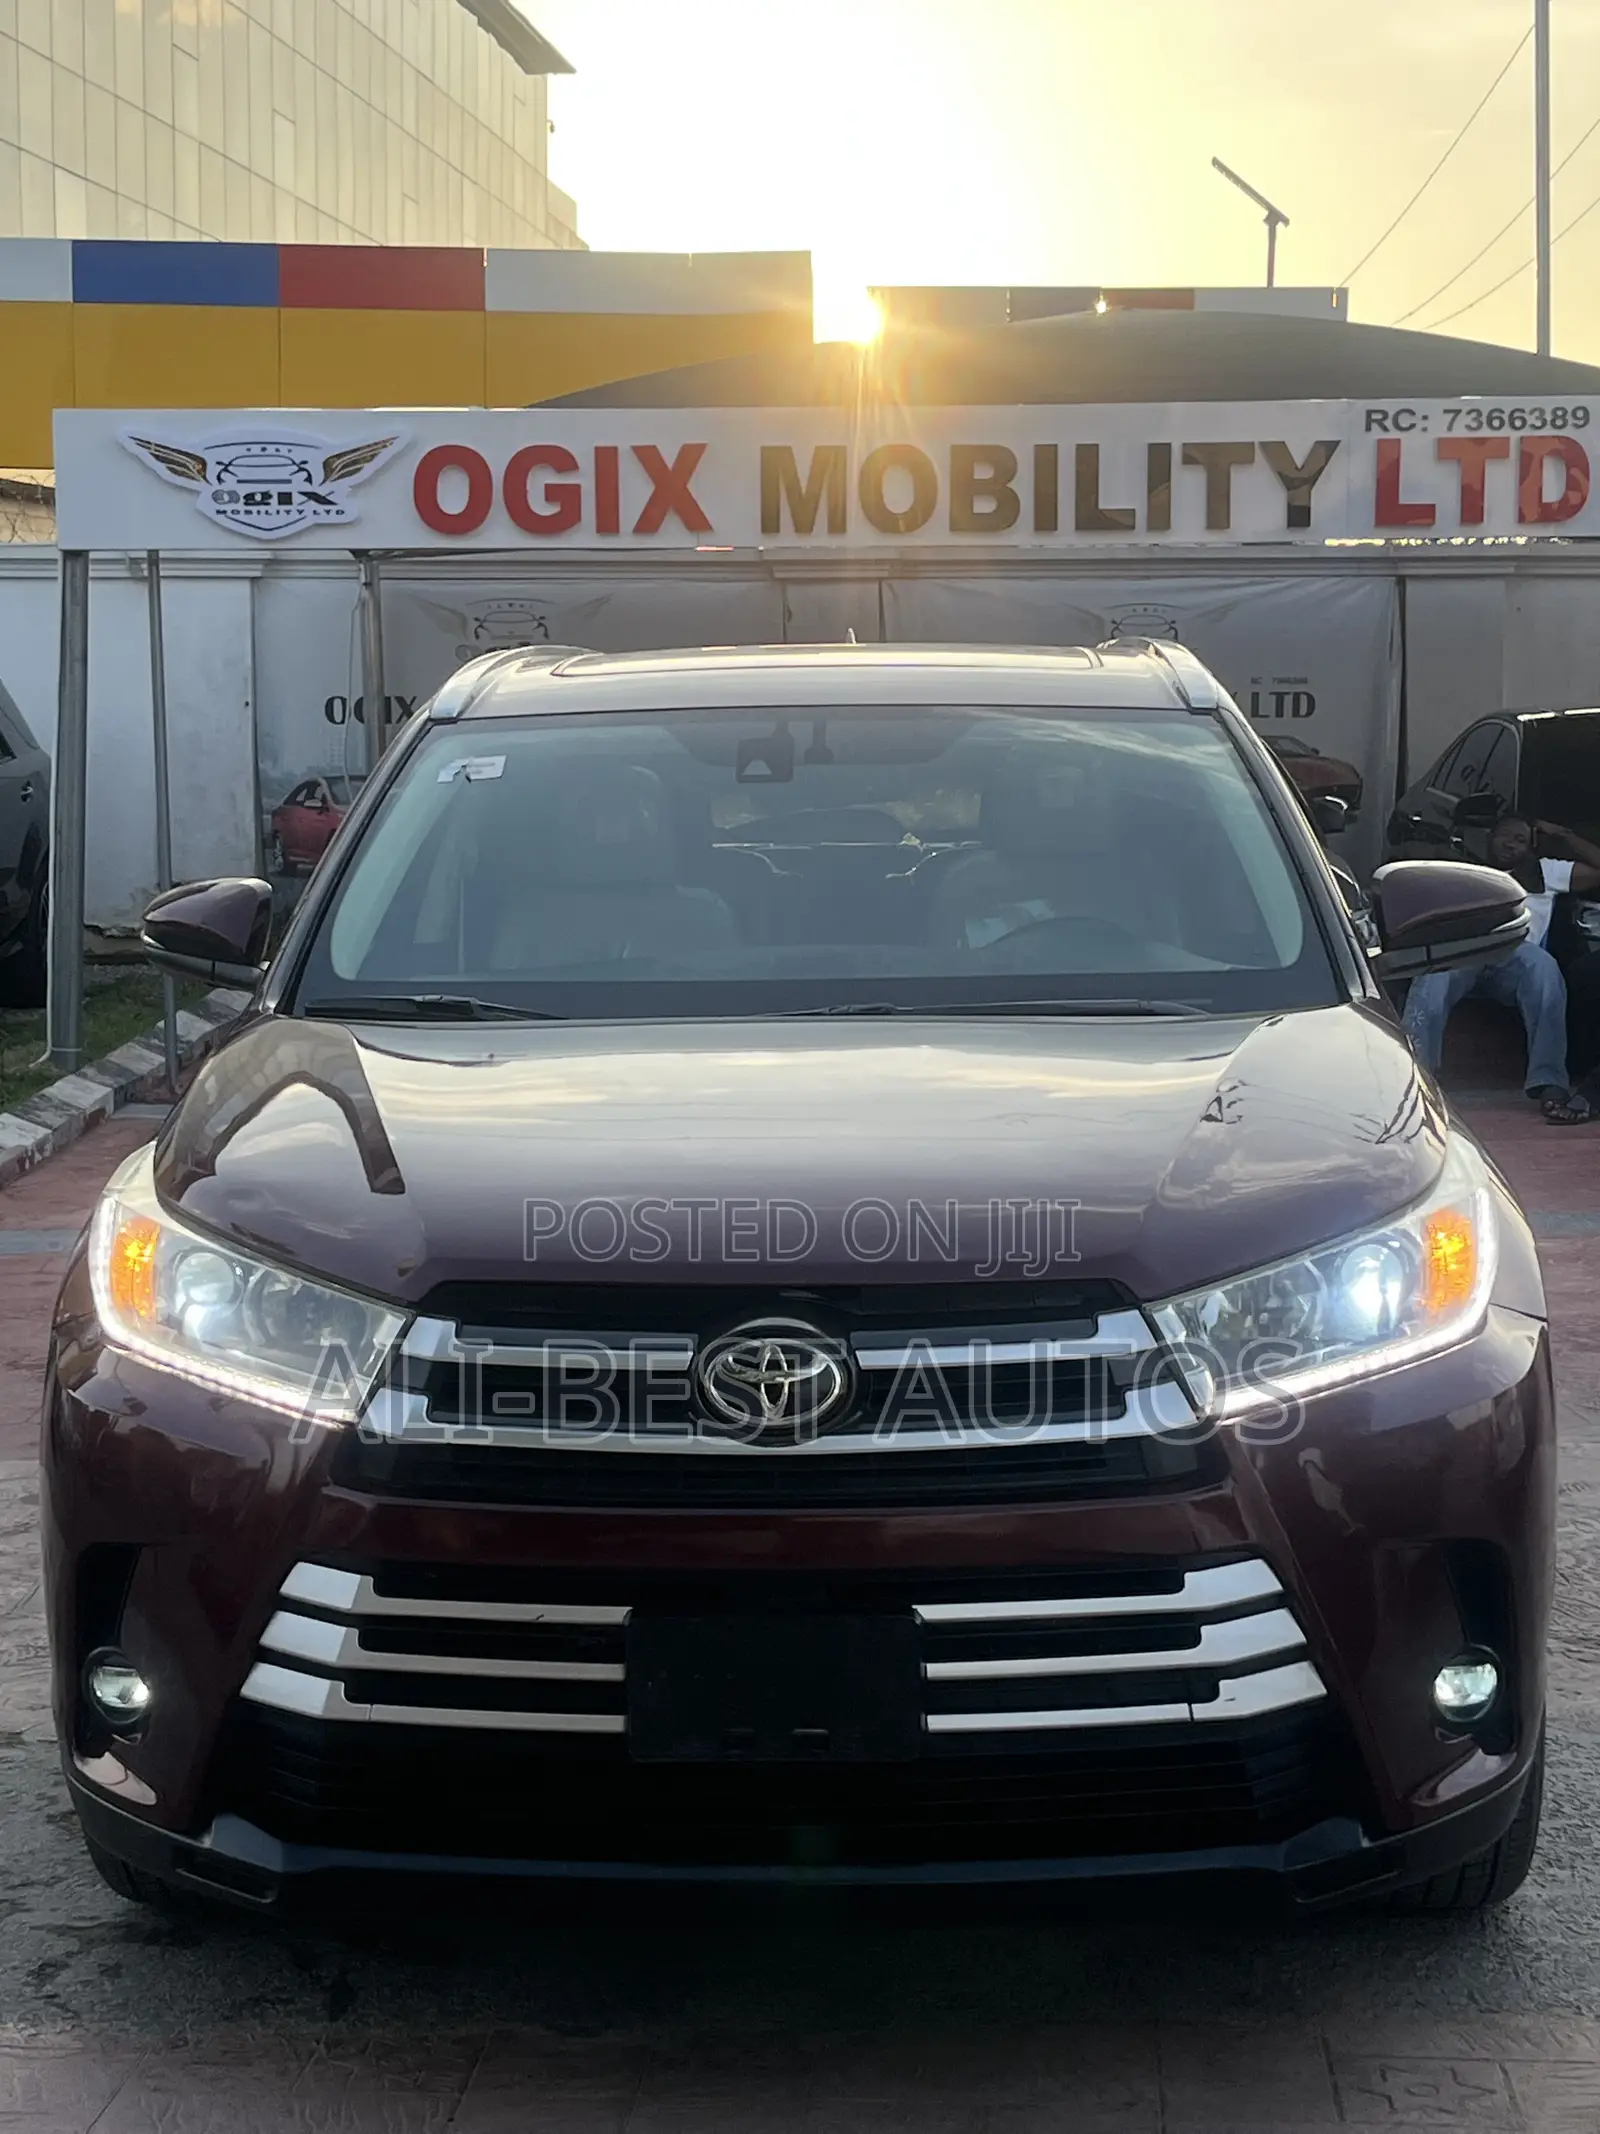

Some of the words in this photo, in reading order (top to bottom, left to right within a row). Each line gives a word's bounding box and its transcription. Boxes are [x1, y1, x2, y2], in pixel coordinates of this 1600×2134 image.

[1364, 408, 1429, 432] RC:
[1442, 406, 1590, 432] 7366389
[413, 443, 714, 535] OGIX
[761, 441, 1341, 533] MOBILITY
[1374, 435, 1590, 527] LTD
[1250, 691, 1316, 718] LTD
